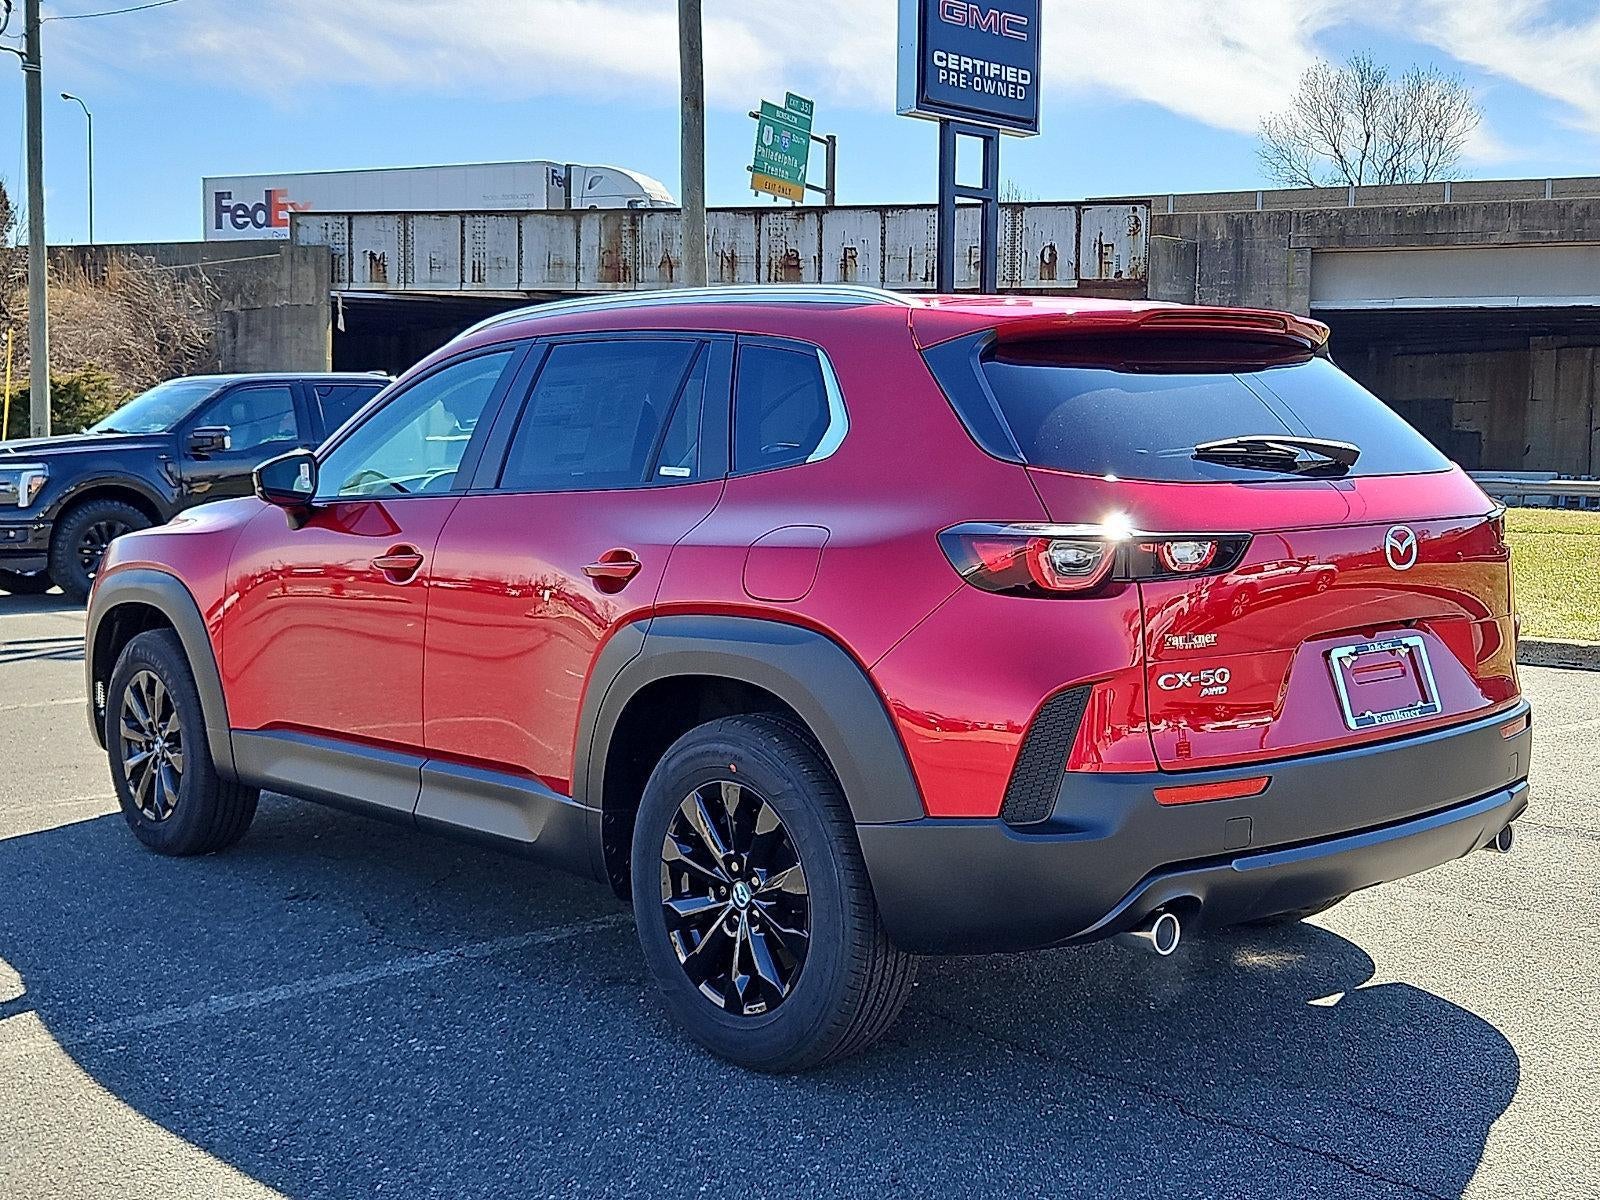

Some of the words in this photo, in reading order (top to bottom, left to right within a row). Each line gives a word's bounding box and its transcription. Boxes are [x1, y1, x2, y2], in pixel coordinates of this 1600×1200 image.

[940, 0, 1028, 41] GMC
[933, 50, 1031, 85] CERTIFIED
[939, 69, 1026, 100] PRE-OWNED
[800, 101, 811, 114] 351
[781, 137, 789, 148] 95
[757, 145, 798, 168] Philadelphia
[763, 162, 789, 179] Trenton
[764, 181, 776, 190] EXIT
[778, 184, 791, 196] ONLY
[1163, 632, 1218, 646] Faulkner
[1157, 667, 1231, 691] CX-50
[1200, 685, 1228, 697] AWD
[1374, 709, 1421, 724] Faulkner
